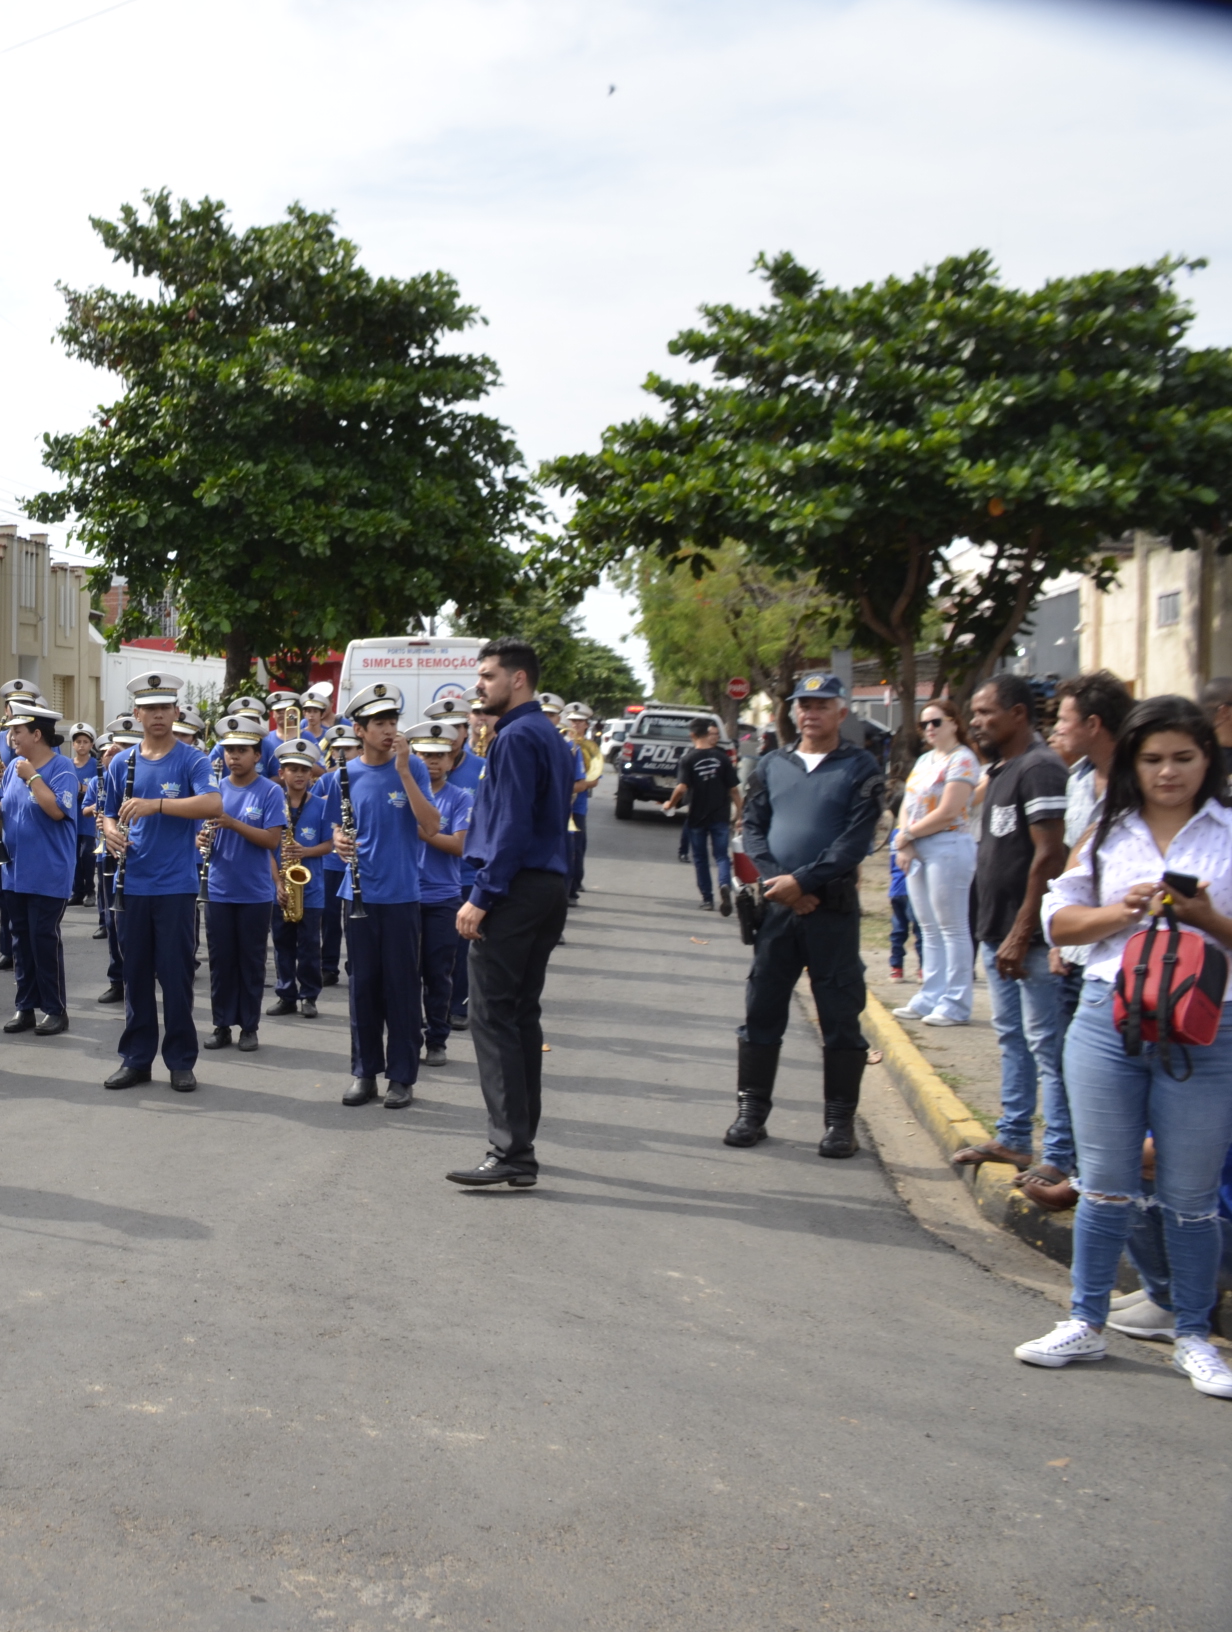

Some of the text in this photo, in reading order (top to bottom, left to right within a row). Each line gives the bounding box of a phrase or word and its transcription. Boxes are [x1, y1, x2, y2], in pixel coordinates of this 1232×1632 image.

[362, 655, 477, 670] SIMPLES REMOÇÃO
[642, 762, 677, 771] MILITAR
